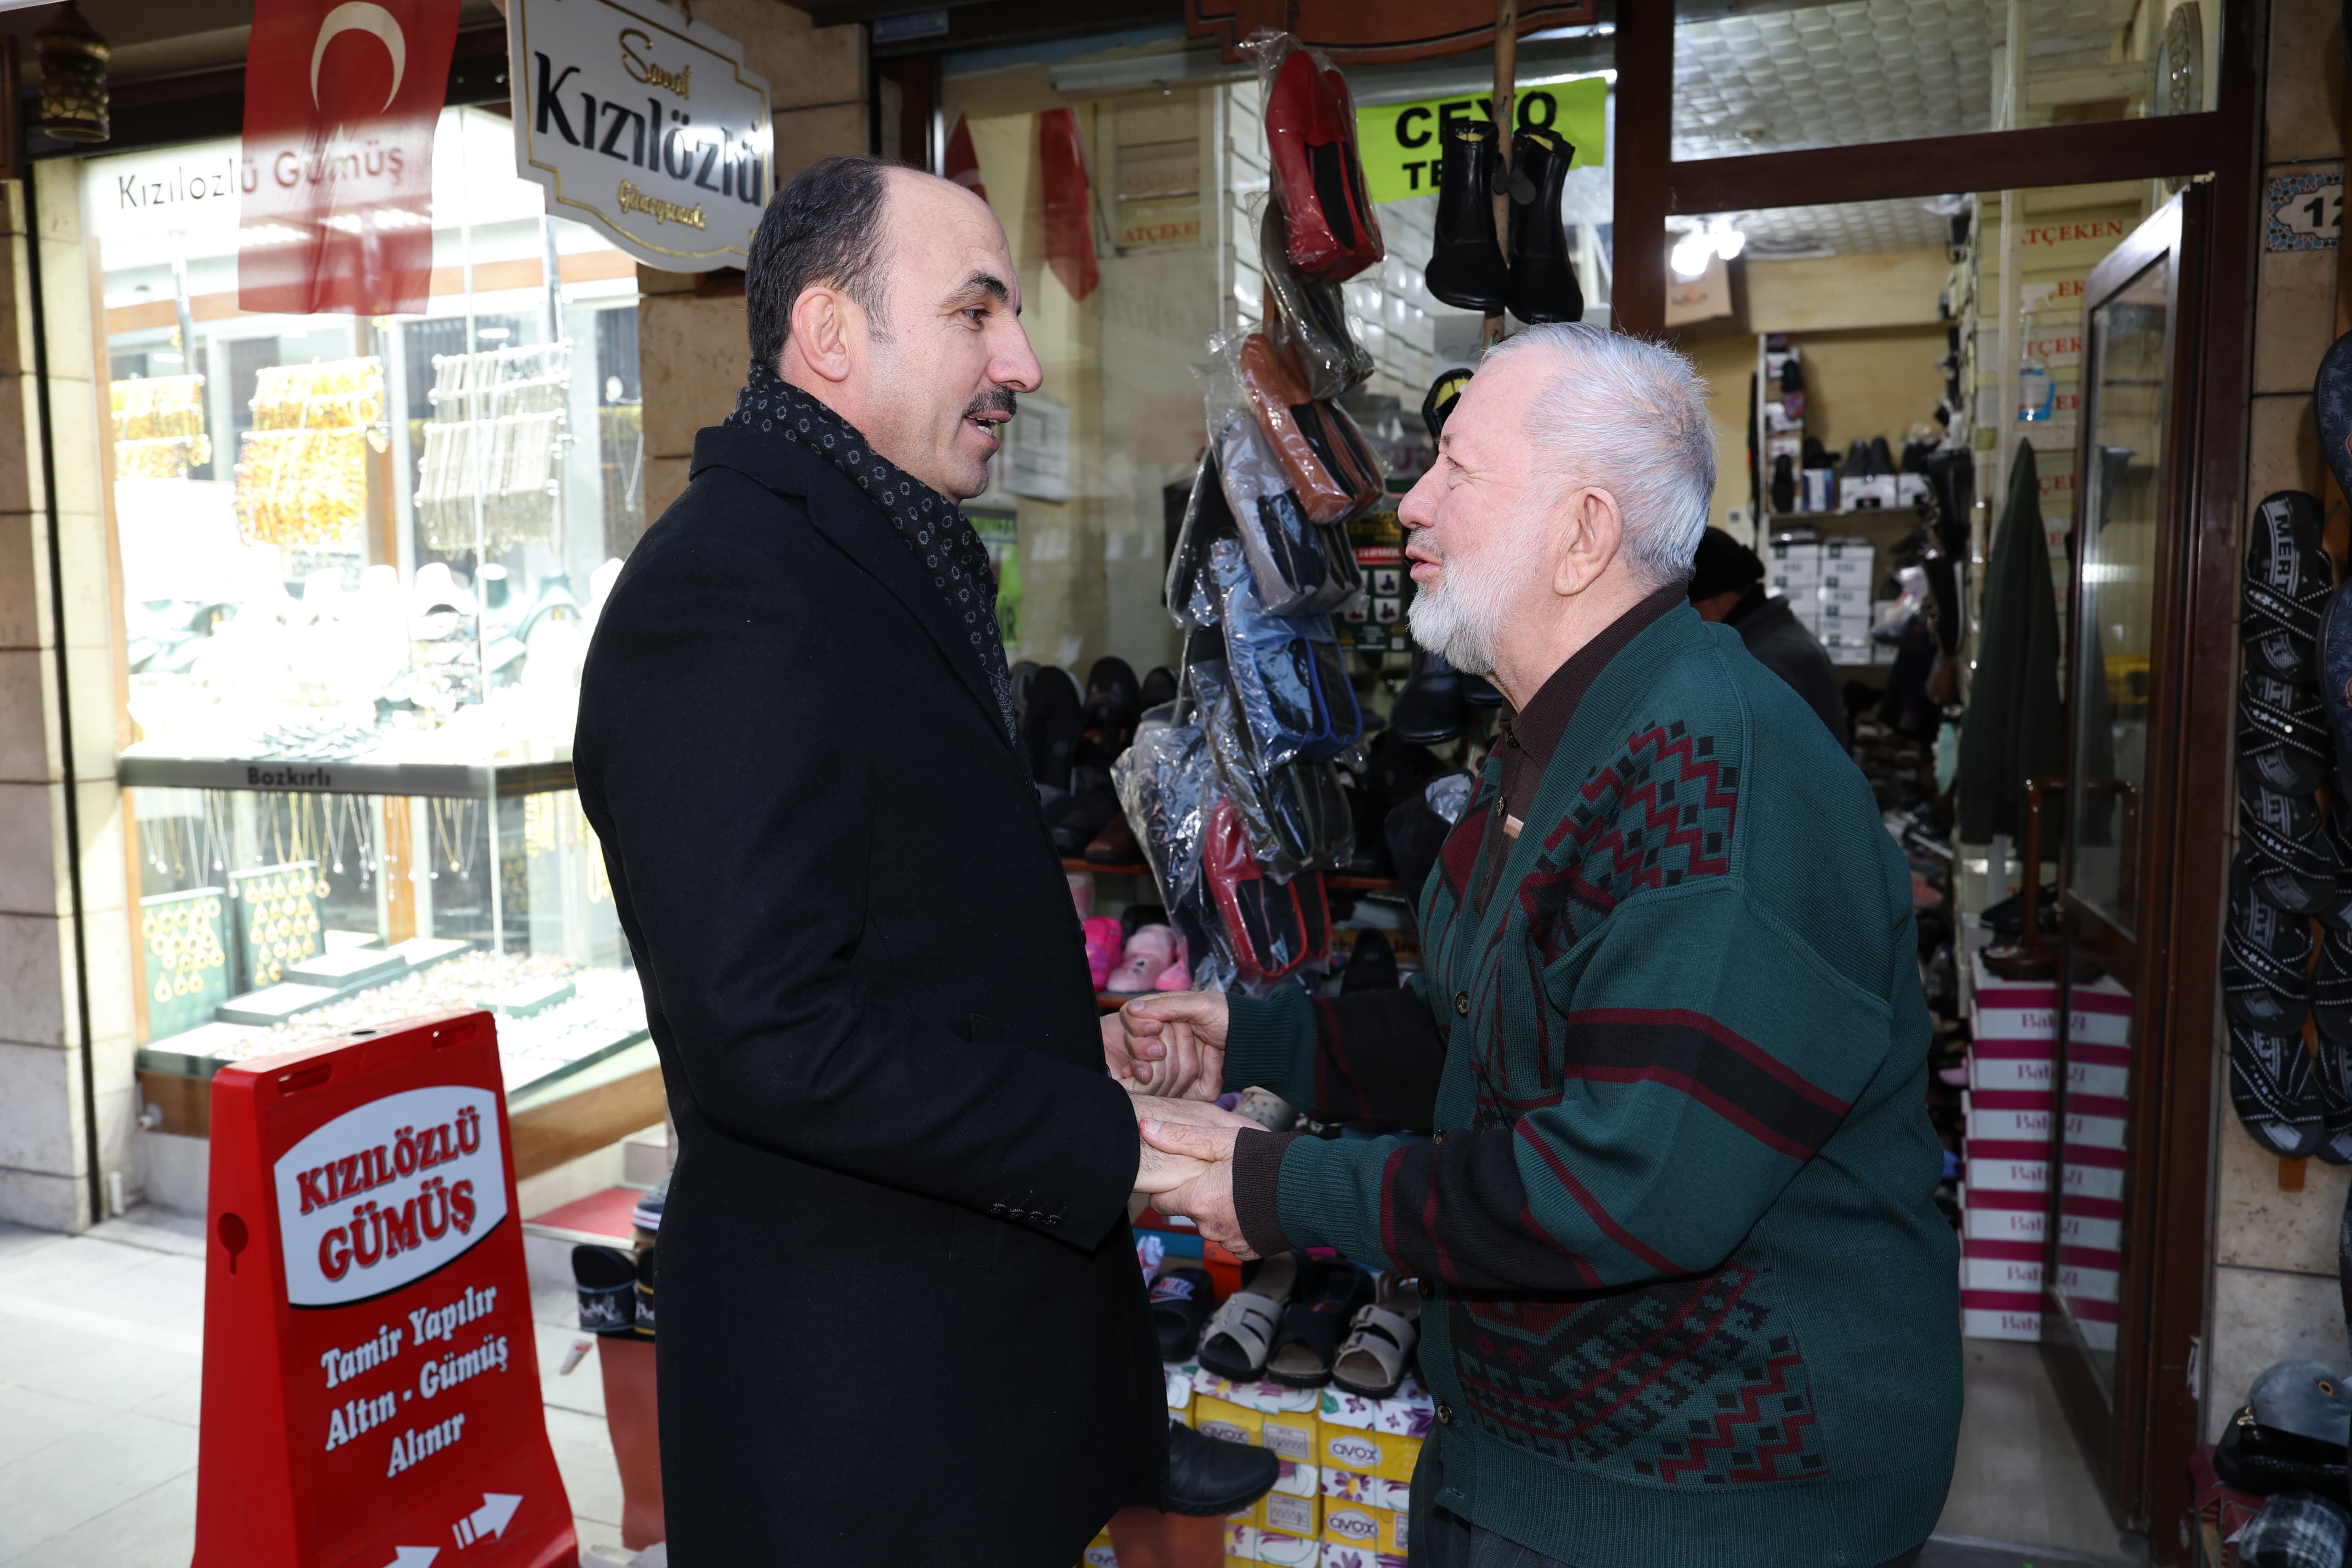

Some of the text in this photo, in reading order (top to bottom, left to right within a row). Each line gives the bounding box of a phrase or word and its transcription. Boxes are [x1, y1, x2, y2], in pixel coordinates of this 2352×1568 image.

[2021, 220, 2124, 247] TÇEKEN
[247, 765, 332, 787] Bozkırlı
[295, 1104, 481, 1215] KIZILÖZLÜ
[318, 1177, 476, 1282] GÜMÜŞ
[320, 1285, 498, 1389] Tamir Yapılır
[324, 1387, 397, 1452] Altın
[418, 1333, 509, 1399] Gümüş
[386, 1411, 466, 1480] Alınır
